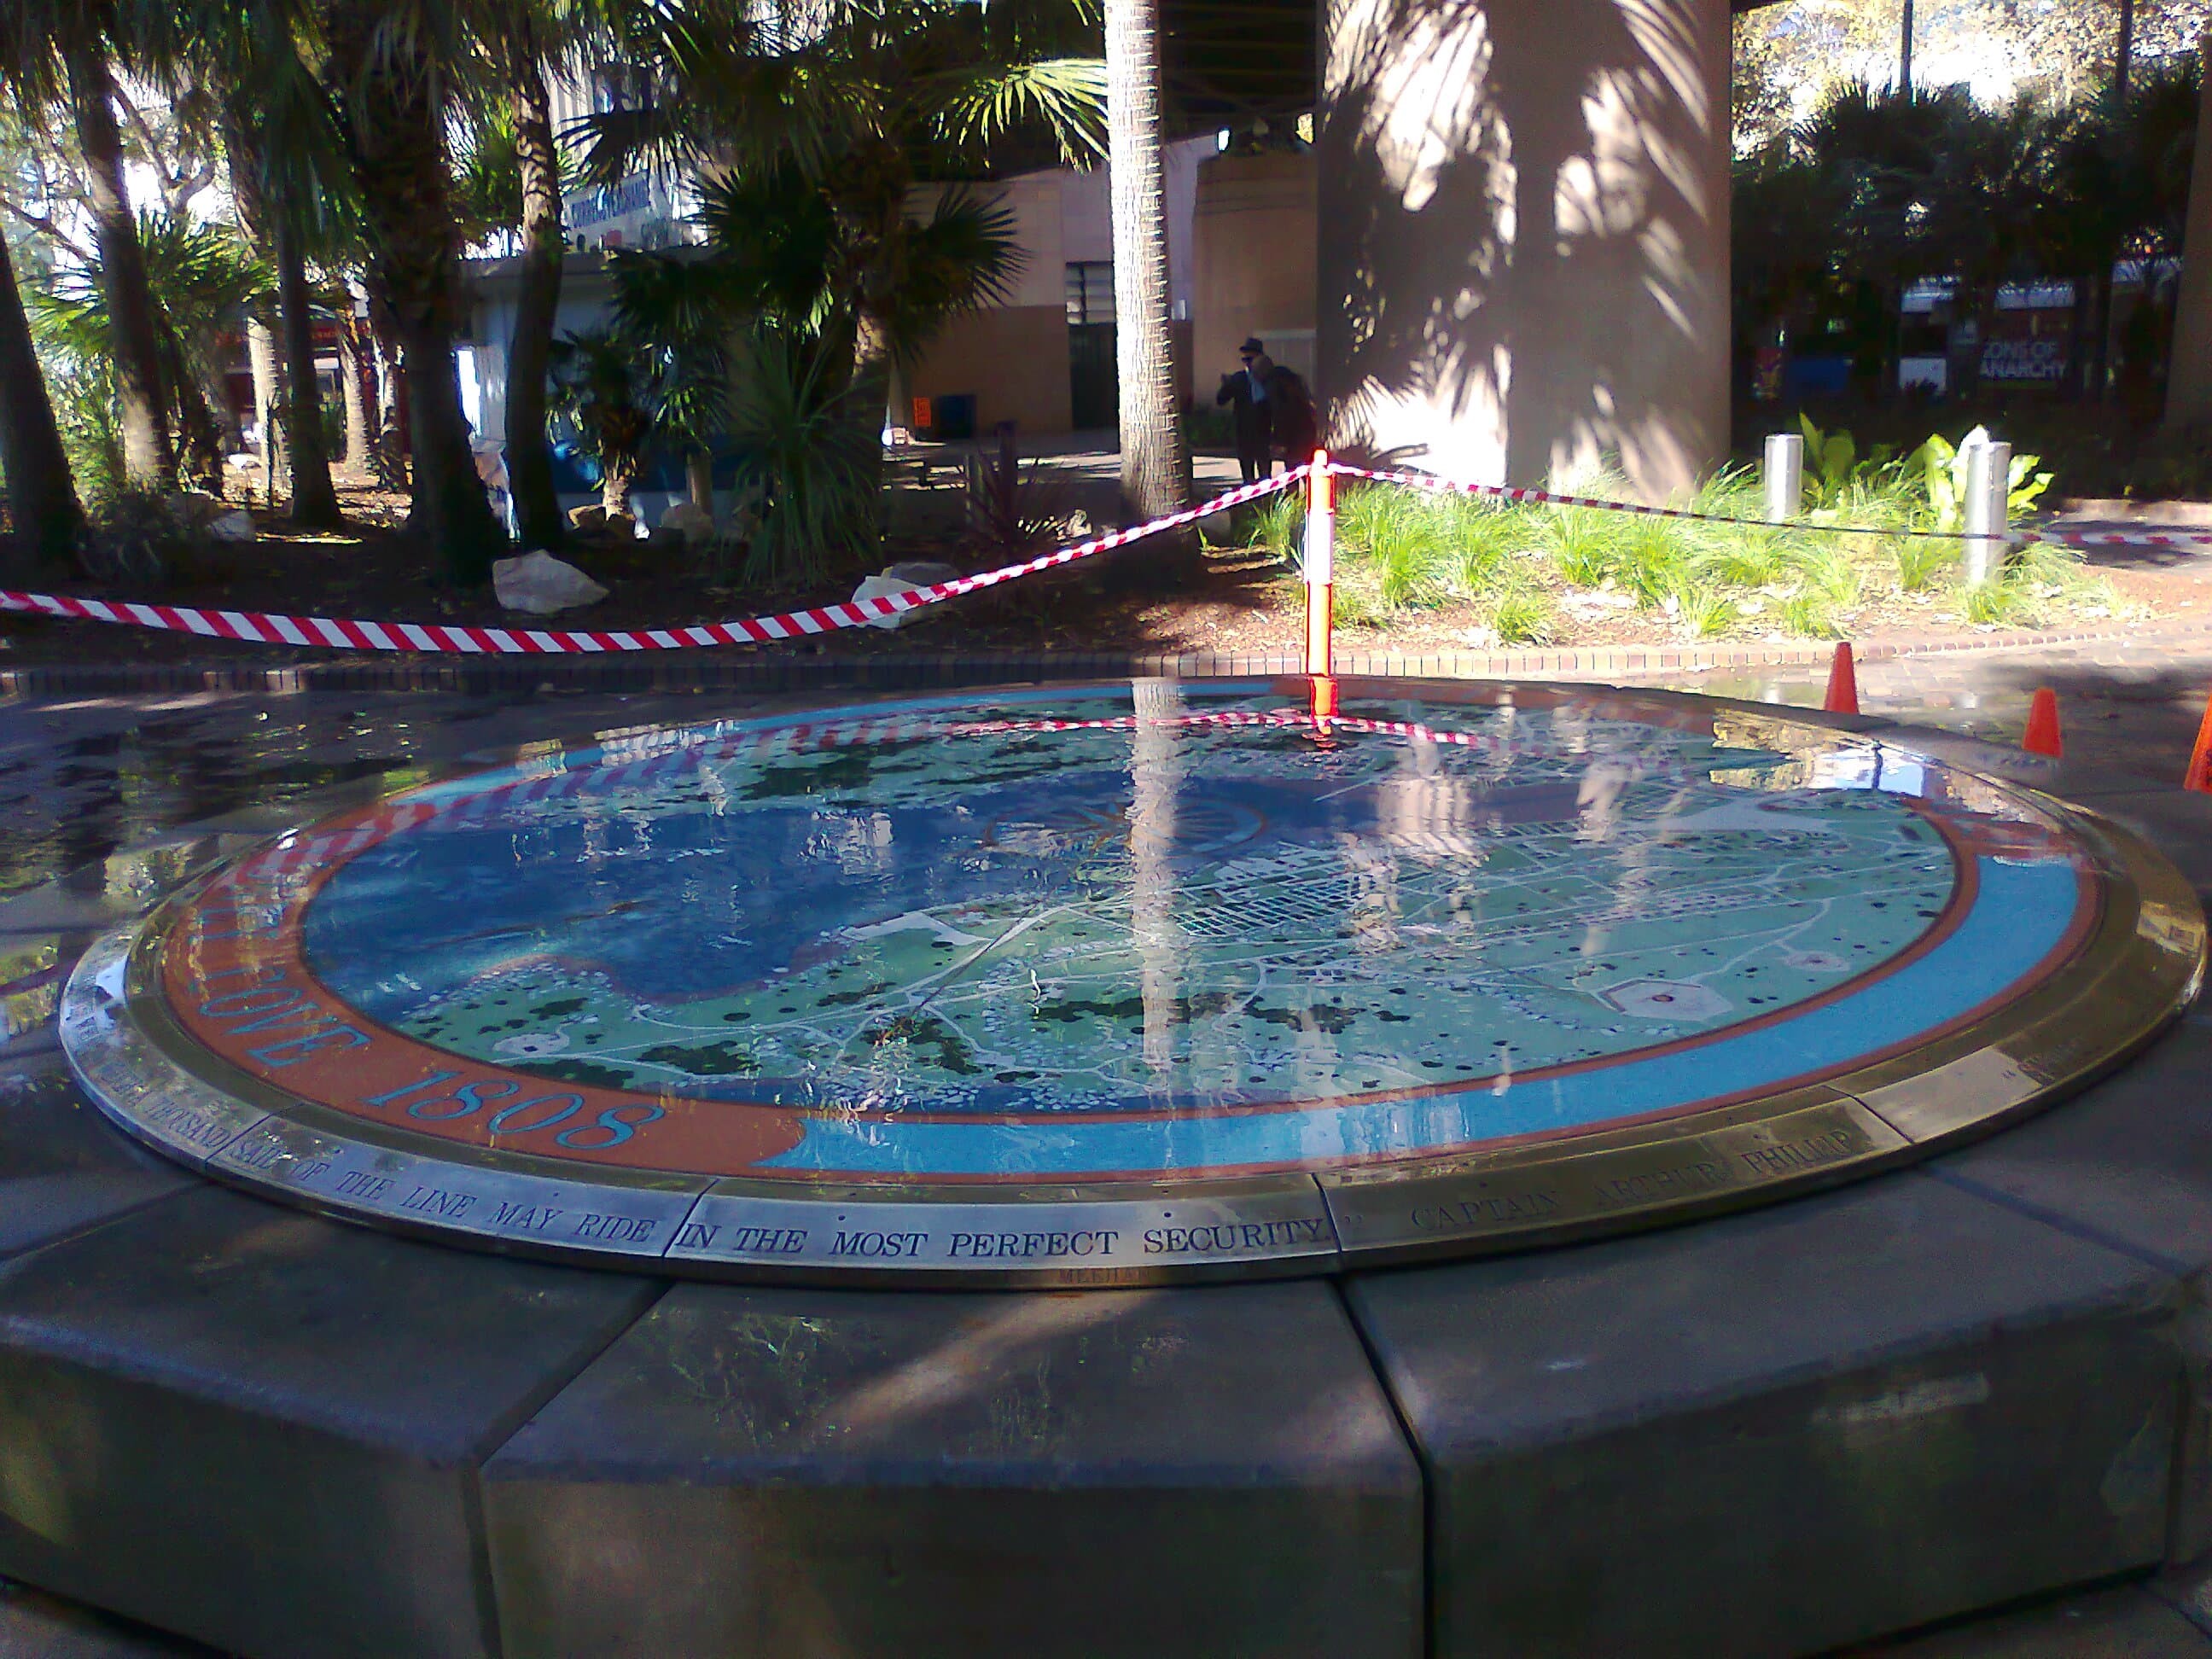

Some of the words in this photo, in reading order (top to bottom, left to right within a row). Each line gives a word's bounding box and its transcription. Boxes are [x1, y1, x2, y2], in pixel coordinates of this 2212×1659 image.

[355, 1070, 666, 1150] 1808
[290, 1159, 331, 1182] OF
[335, 1171, 396, 1201] THE
[399, 1186, 478, 1219] LINE
[489, 1201, 563, 1231] MAY
[574, 1213, 658, 1243] RIDE
[675, 1222, 722, 1249] IN
[733, 1227, 807, 1254] THE
[828, 1231, 929, 1257] MOST
[946, 1231, 1119, 1257] PERFECT
[1411, 1193, 1560, 1231] CAPTAIN
[1592, 1161, 1721, 1208] ARTHUR
